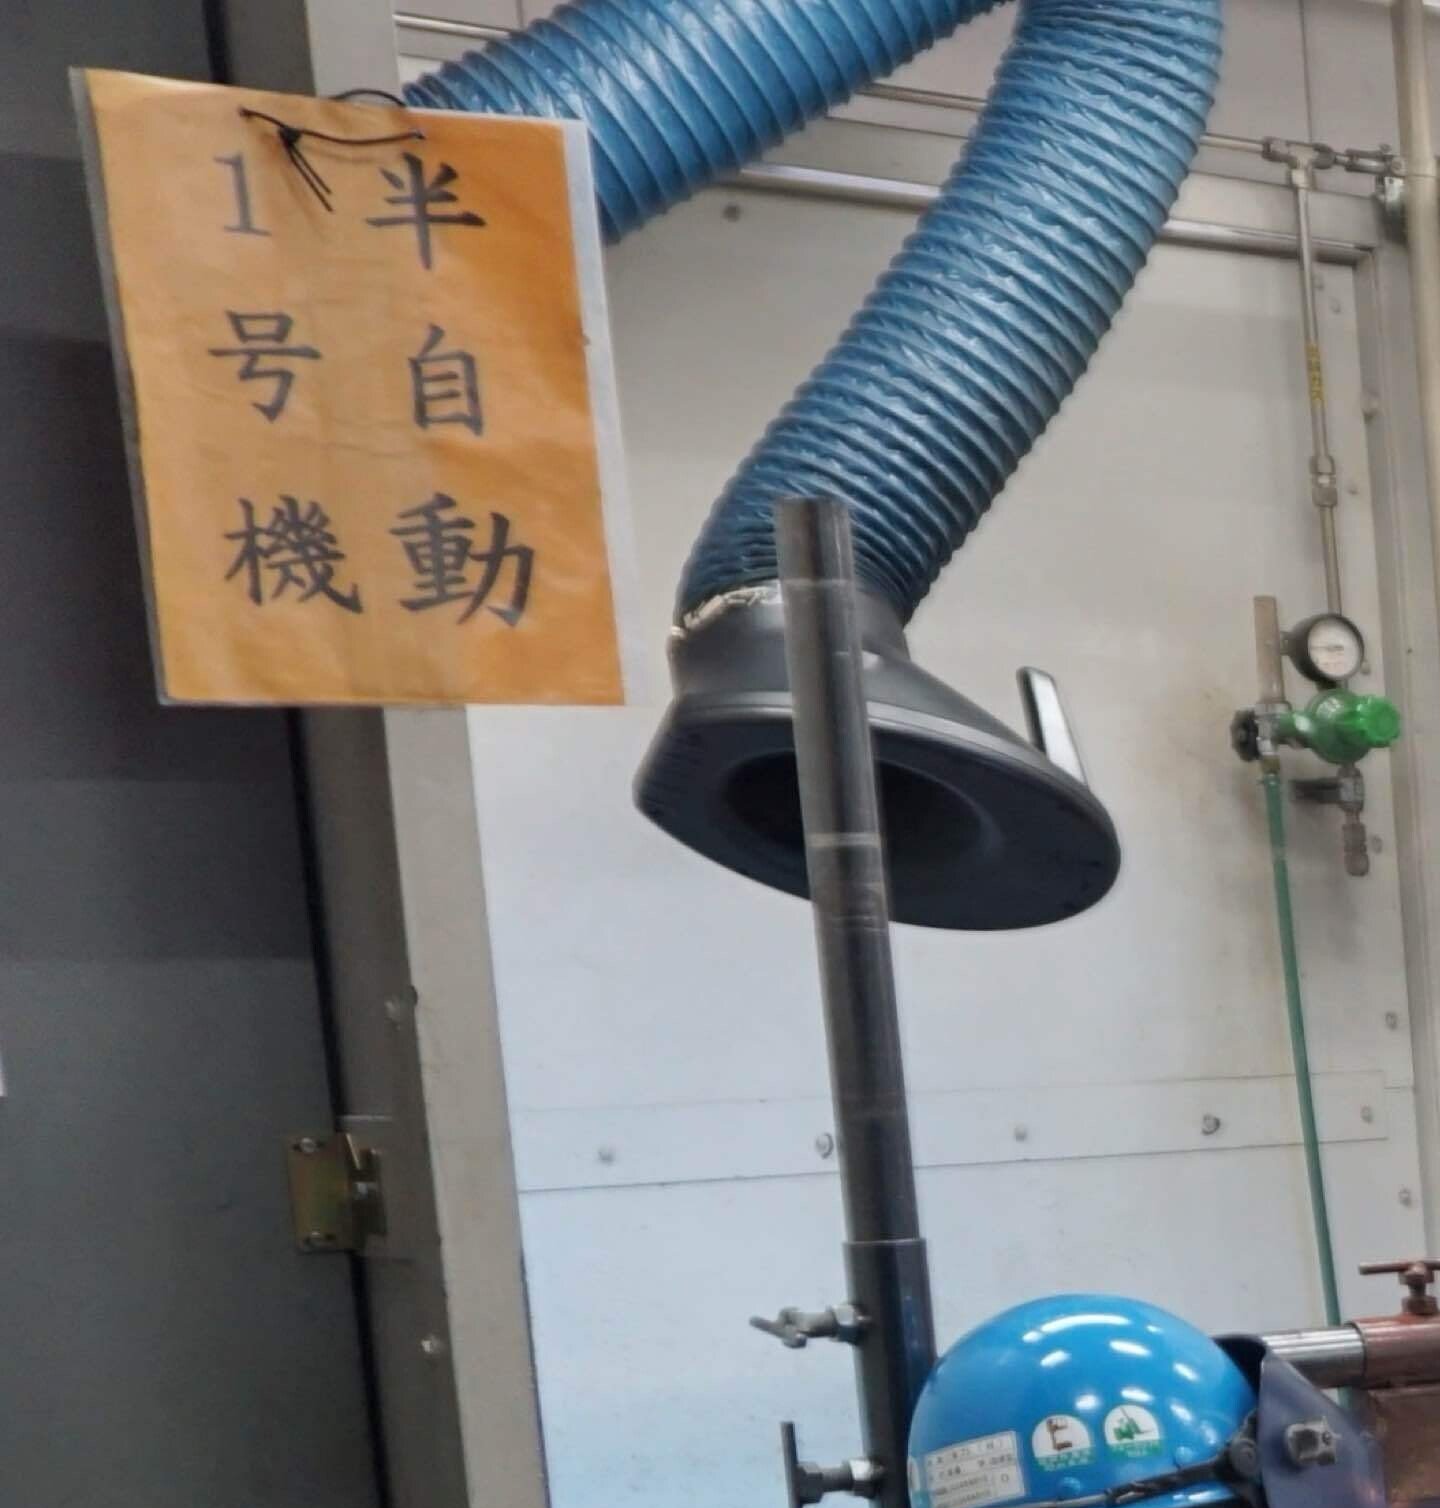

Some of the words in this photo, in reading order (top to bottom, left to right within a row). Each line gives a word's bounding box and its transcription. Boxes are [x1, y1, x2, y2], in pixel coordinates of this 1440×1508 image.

[209, 154, 364, 616] 1号機
[367, 151, 536, 629] 半自動
